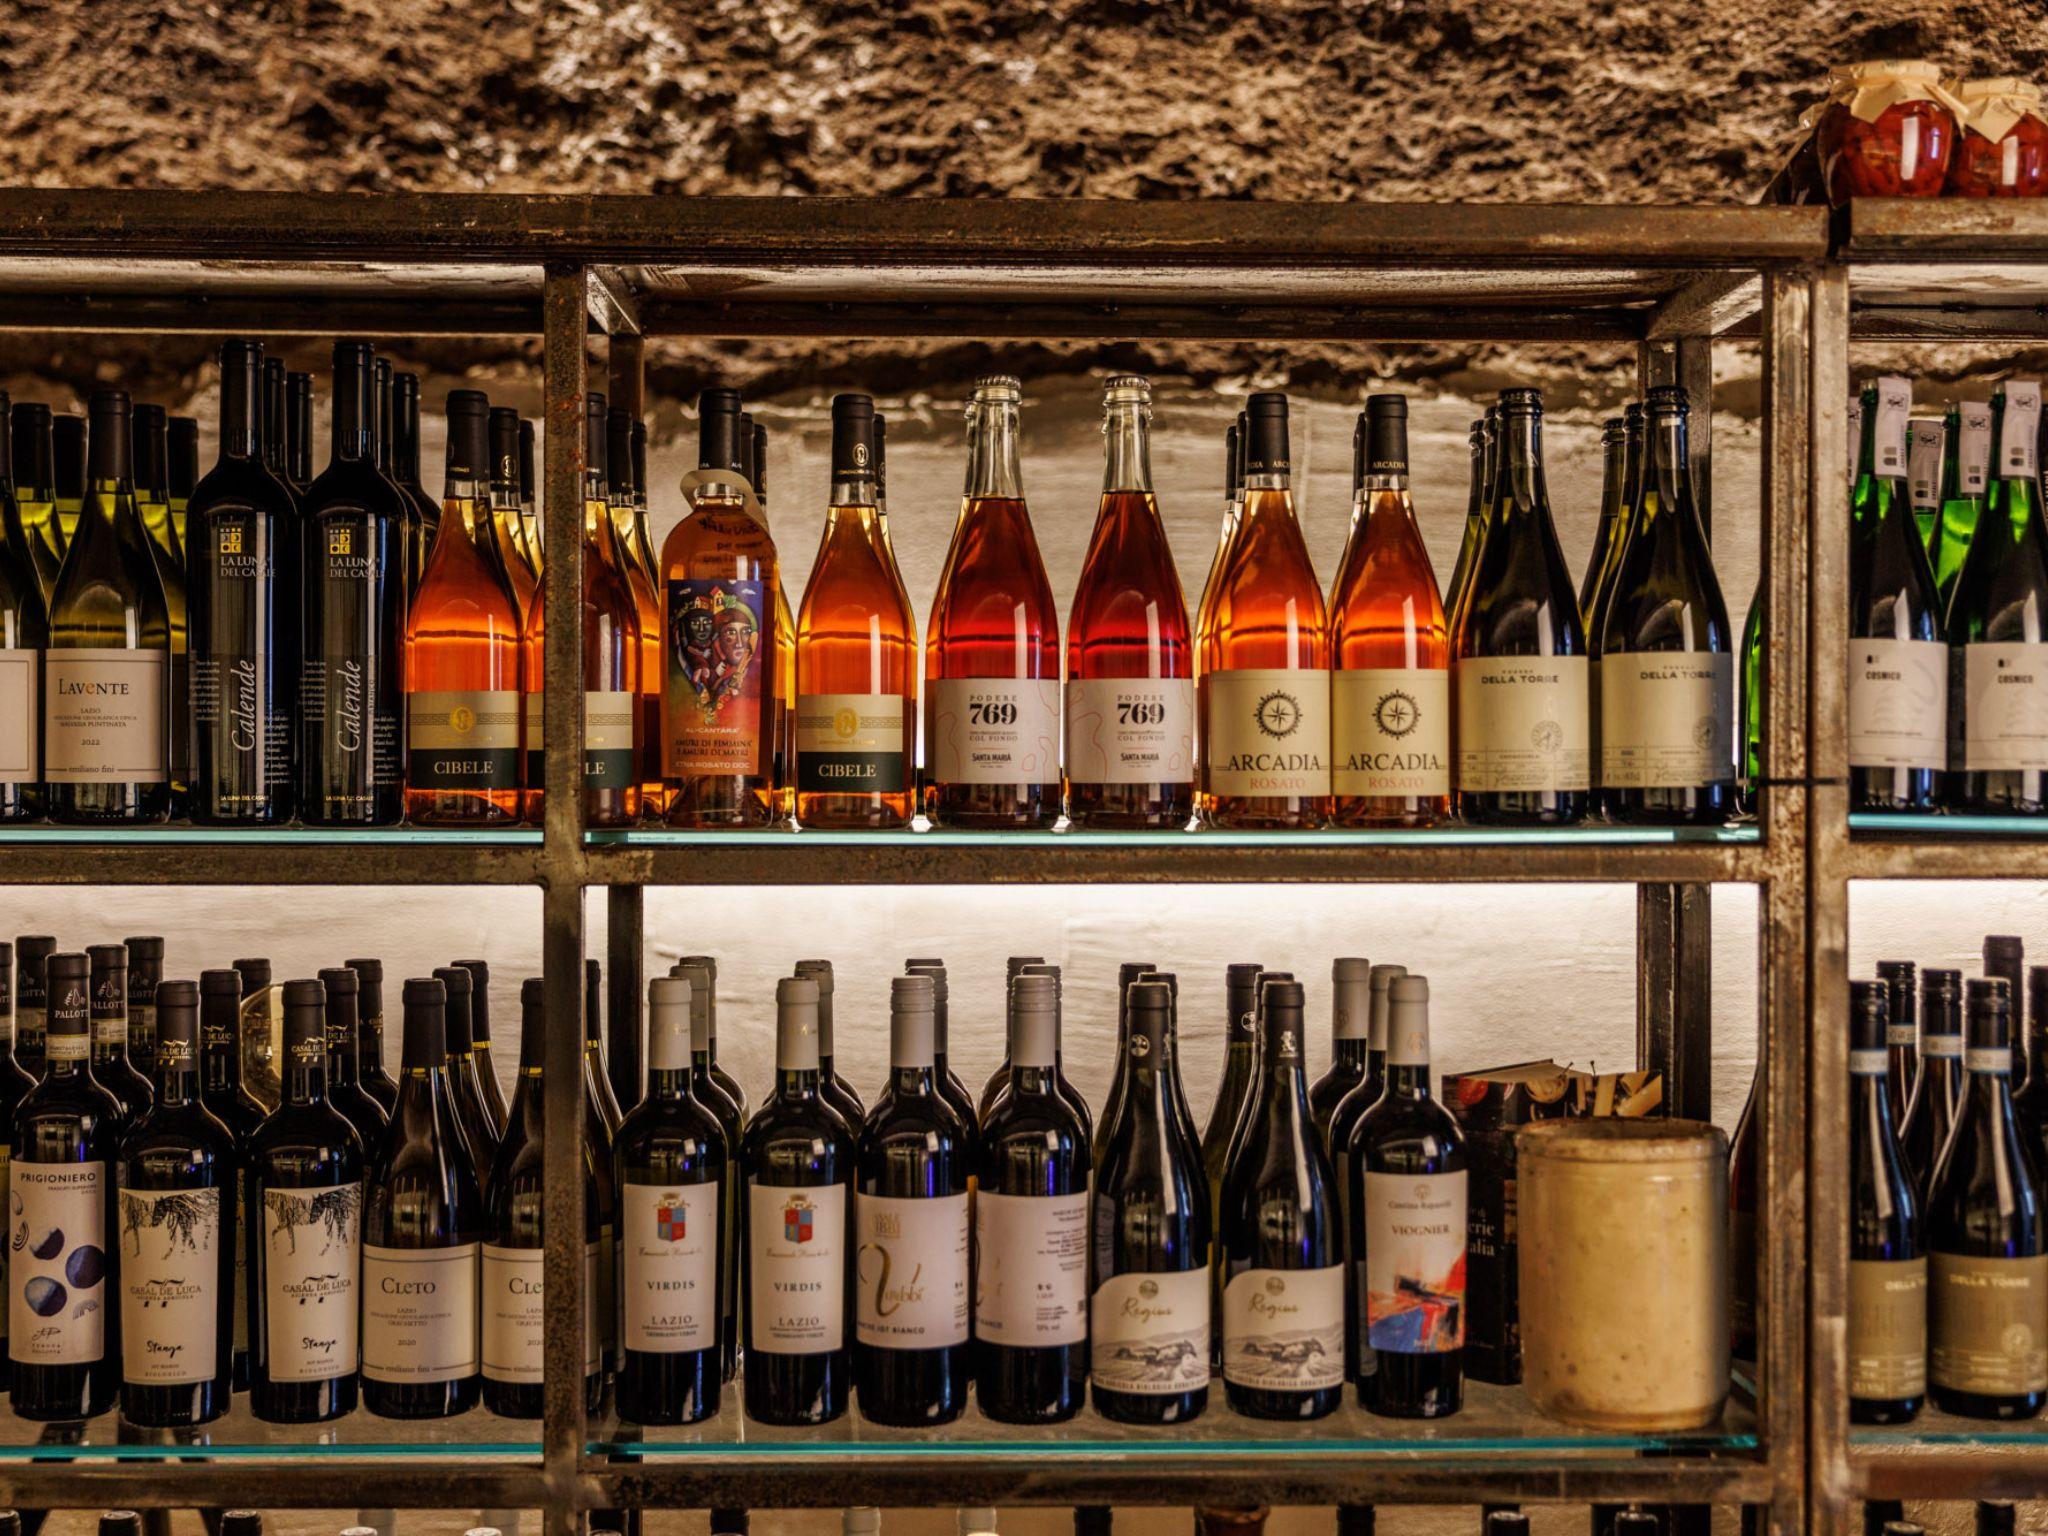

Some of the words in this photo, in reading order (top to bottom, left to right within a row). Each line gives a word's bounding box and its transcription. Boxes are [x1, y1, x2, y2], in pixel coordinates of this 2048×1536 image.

[220, 556, 234, 566] LA
[330, 558, 346, 568] LA
[220, 568, 240, 577] DEL
[330, 569, 348, 578] DEL
[1480, 676, 1516, 684] DELLA
[1520, 675, 1560, 684] TORRE
[1640, 671, 1678, 680] DELLA
[1866, 672, 1902, 680] COSMICO
[1998, 675, 2034, 684] COSMICO
[230, 660, 256, 752] Calende
[336, 660, 361, 752] Calende
[969, 702, 1018, 725] 769
[1117, 702, 1165, 725] 769
[972, 753, 990, 762] SANTA
[1121, 752, 1139, 761] SANTA
[1227, 754, 1321, 772] ARCADIA
[1346, 753, 1440, 771] ARCADIA
[434, 761, 494, 774] CIBELE
[818, 764, 877, 777] CIBELE
[1250, 777, 1306, 789] ROSATO
[1368, 777, 1424, 789] ROSATO
[20, 1172, 96, 1183] PRIGIONIERO
[1392, 1225, 1450, 1236] VIOGNIER
[282, 1284, 314, 1293] CASAL
[317, 1283, 329, 1292] DE
[332, 1280, 352, 1289] LUCA
[646, 1281, 695, 1290] VIRDIS
[774, 1282, 822, 1292] VIRDIS
[130, 1286, 155, 1296] CASAL
[160, 1287, 173, 1296] DE
[176, 1286, 202, 1294] LUCA
[652, 1315, 692, 1325] LAZIO
[778, 1316, 819, 1326] LAZIO
